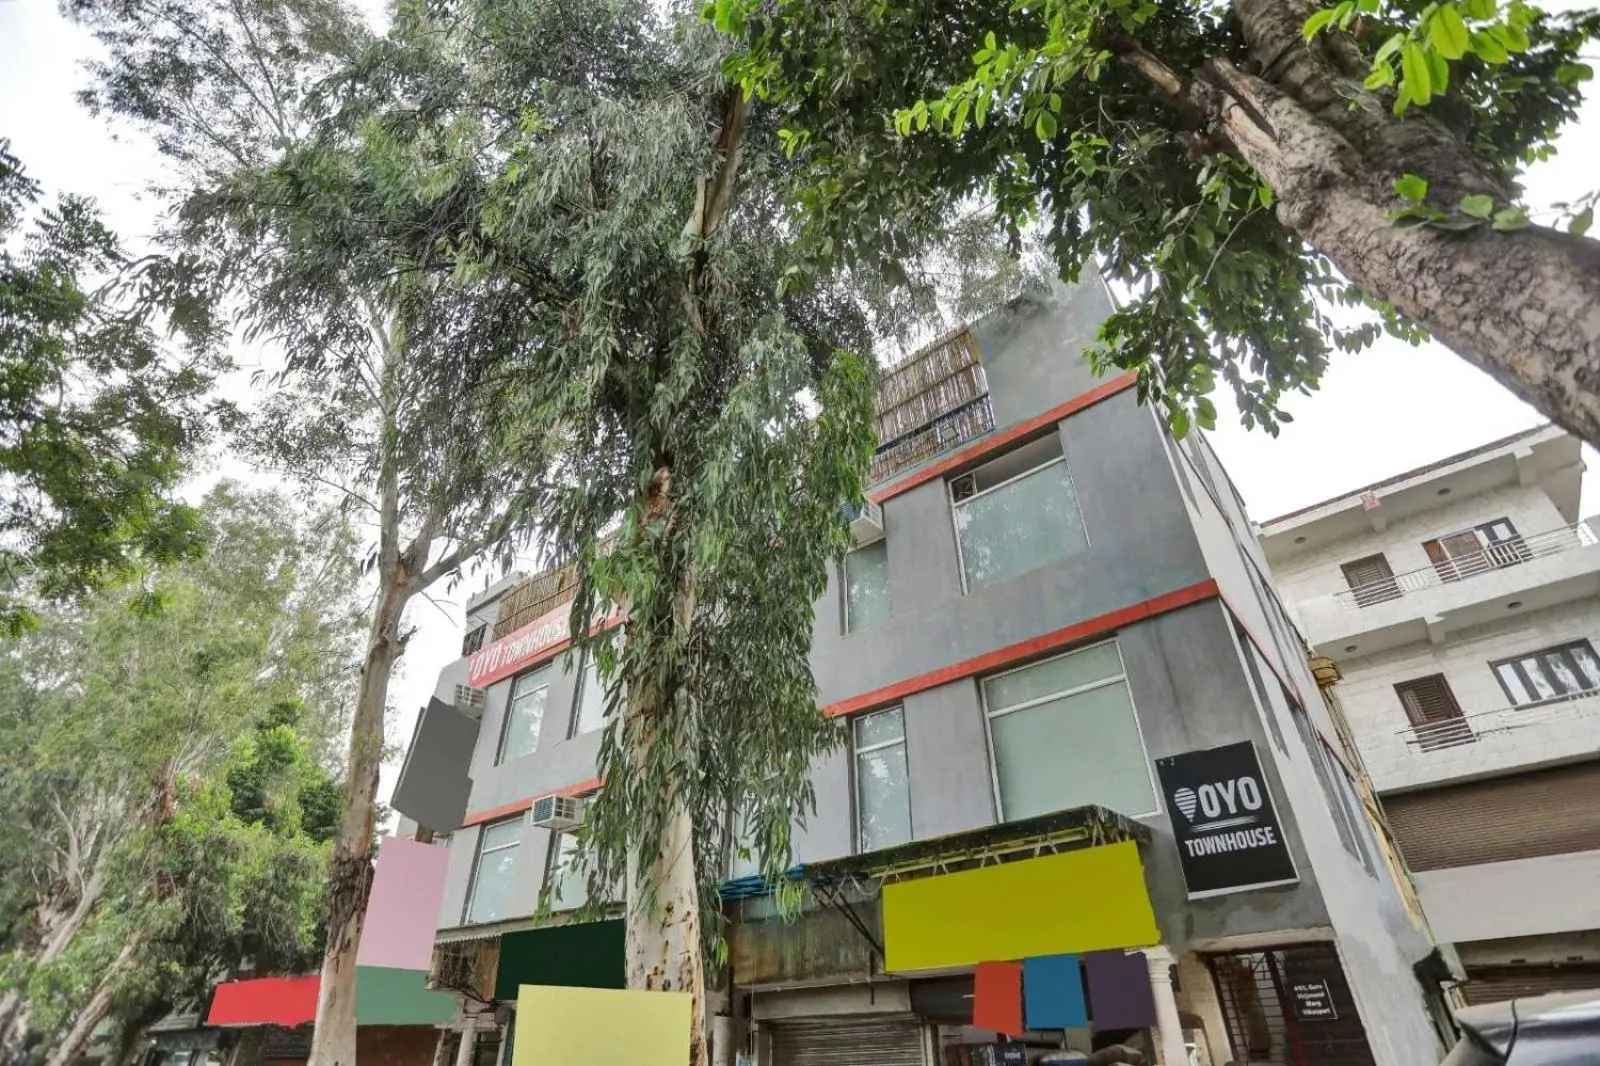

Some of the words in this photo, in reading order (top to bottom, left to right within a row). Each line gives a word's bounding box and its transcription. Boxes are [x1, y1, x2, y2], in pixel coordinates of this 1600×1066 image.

[472, 643, 502, 681] OYO
[1198, 776, 1262, 818] OYO
[1184, 826, 1277, 857] TOWNHOUSE
